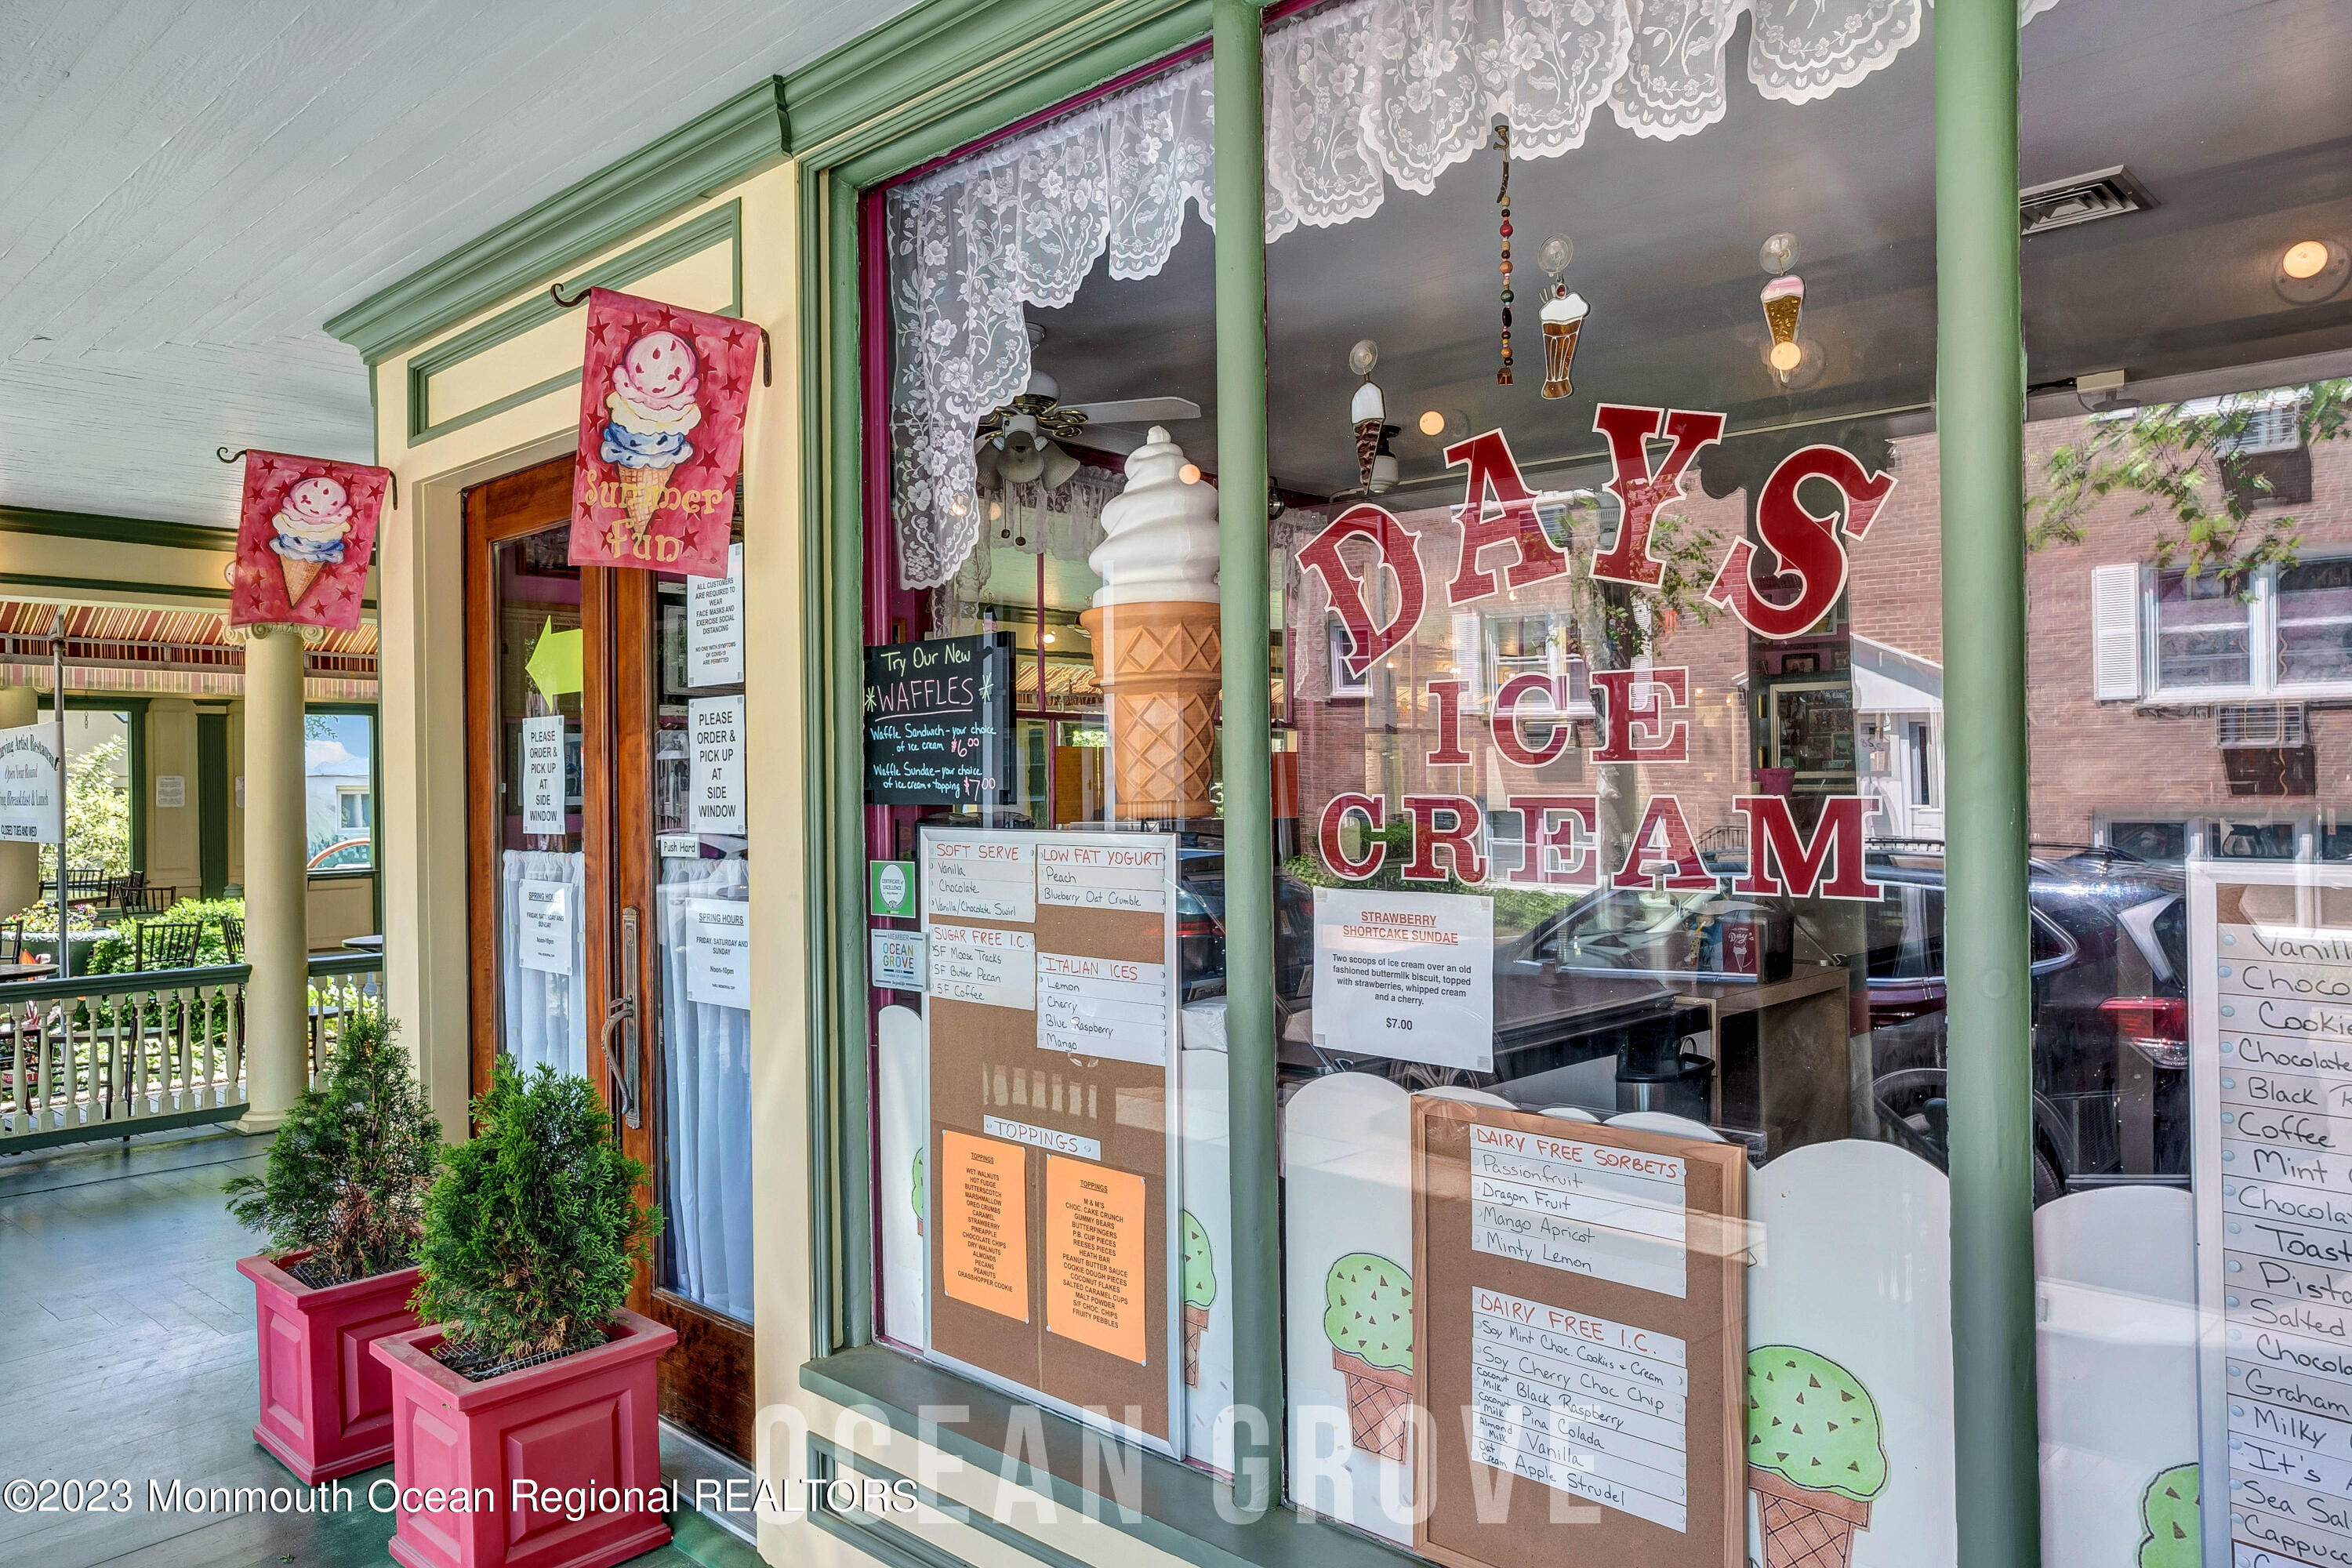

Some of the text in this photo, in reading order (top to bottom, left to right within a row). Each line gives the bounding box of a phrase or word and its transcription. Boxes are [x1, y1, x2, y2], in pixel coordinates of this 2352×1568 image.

[585, 470, 723, 514] Summer
[607, 518, 680, 562] Fun
[1295, 403, 1899, 679] DAYS
[707, 577, 734, 589] CUSTOMERS
[706, 587, 728, 598] REQUIRED
[702, 625, 729, 634] DISTANCING
[880, 643, 971, 677] Try Our New
[699, 711, 733, 726] PLEASE
[1426, 666, 1690, 768] ICE
[531, 731, 555, 742] PLEASE
[697, 730, 736, 745] ORDER &
[529, 747, 558, 758] ORDER &
[699, 749, 734, 763] PICK UP
[531, 763, 556, 774] PICK UP
[712, 768, 722, 780] AT
[539, 779, 548, 789] AT
[707, 786, 727, 799] SIDE
[535, 795, 550, 806] SIDE
[529, 811, 557, 822] WINDOW
[699, 804, 736, 818] WINDOW
[663, 841, 695, 853] Push Hard
[936, 844, 1019, 861] SOFT SERVE
[1319, 793, 1884, 902] CREAM
[1043, 848, 1163, 866] LOW FAT YOGURT
[938, 861, 966, 877] Vanilla
[1045, 866, 1076, 884] Peach
[939, 879, 979, 894] Chocolate
[1044, 887, 1141, 906] Blueberry Oat Crumble
[699, 913, 744, 924] SPRING HOURS
[994, 903, 1016, 916] Swirl
[1361, 912, 1436, 926] STRAWBERRY
[713, 938, 737, 947] SATURDAY
[935, 927, 1029, 948] SUGAR FREE I.C.
[1343, 925, 1458, 943] SHORTCAKE SUNDAE
[883, 943, 914, 956] OCEAN
[934, 946, 1002, 964] SF Moose Tracks
[883, 955, 914, 969] GROVE
[1043, 956, 1138, 981] ITALIAN ICES
[1333, 953, 1347, 963] Two
[1349, 956, 1376, 966] scoops
[1388, 959, 1399, 967] ice
[1401, 961, 1425, 970] cream
[1459, 965, 1472, 974] old
[935, 964, 1001, 983] SF Butter Pecan
[1333, 965, 1471, 987] fashioned buttermilk biscuit, topped
[937, 984, 985, 1000] SF Coffee
[1047, 976, 1080, 992] Lemon
[1337, 977, 1352, 986] with
[1355, 979, 1403, 992] strawberries,
[1406, 984, 1439, 995] whipped
[1047, 996, 1078, 1014] Cherry
[1374, 993, 1389, 1001] and
[1397, 994, 1425, 1007] cherry.
[1046, 1014, 1114, 1039] Blue Raspberry
[1386, 1018, 1413, 1030] $7.00
[1047, 1033, 1078, 1052] Mango
[2239, 1038, 2352, 1072] Chocolate
[2249, 1077, 2318, 1105] Black
[993, 1120, 1079, 1154] TOPPINGS
[2238, 1112, 2336, 1149] Coffee
[970, 1152, 994, 1164] TOPPINGS
[1476, 1128, 1678, 1178] DAIRY FREE SORBETS
[1483, 1154, 1583, 1189] Passionfruit
[2254, 1149, 2327, 1184] Mint
[964, 1183, 1002, 1198] BUTTERSCOTCH
[1080, 1180, 1108, 1192] TOPPINGS
[964, 1192, 1002, 1206] MARSHMALLOW
[1483, 1182, 1570, 1211] Dragon Fruit
[967, 1217, 1000, 1230] STRAWBERRY
[971, 1225, 997, 1238] PINEAPPLE
[1072, 1221, 1117, 1239] BUTTERFINGERS
[1484, 1206, 1595, 1244] Mango Apricot
[973, 1250, 996, 1262] ALMONDS
[1487, 1231, 1592, 1272] Minty Lemon
[975, 1259, 994, 1270] PECANS
[1481, 1293, 1657, 1355] DAIRY FREE I.C.
[2250, 1298, 2346, 1337] Salted
[1483, 1346, 1664, 1414] Soy Cherry Choc Chip
[2245, 1368, 2350, 1417] Graham
[1516, 1382, 1624, 1431] Black Raspberry
[1522, 1406, 1605, 1450] Pina Colada
[2254, 1406, 2327, 1449] Milky
[1526, 1432, 1584, 1467] Vanilla
[2244, 1442, 2321, 1483] It's
[1515, 1455, 1625, 1505] Apple Strudel
[2243, 1480, 2296, 1515] Sea
